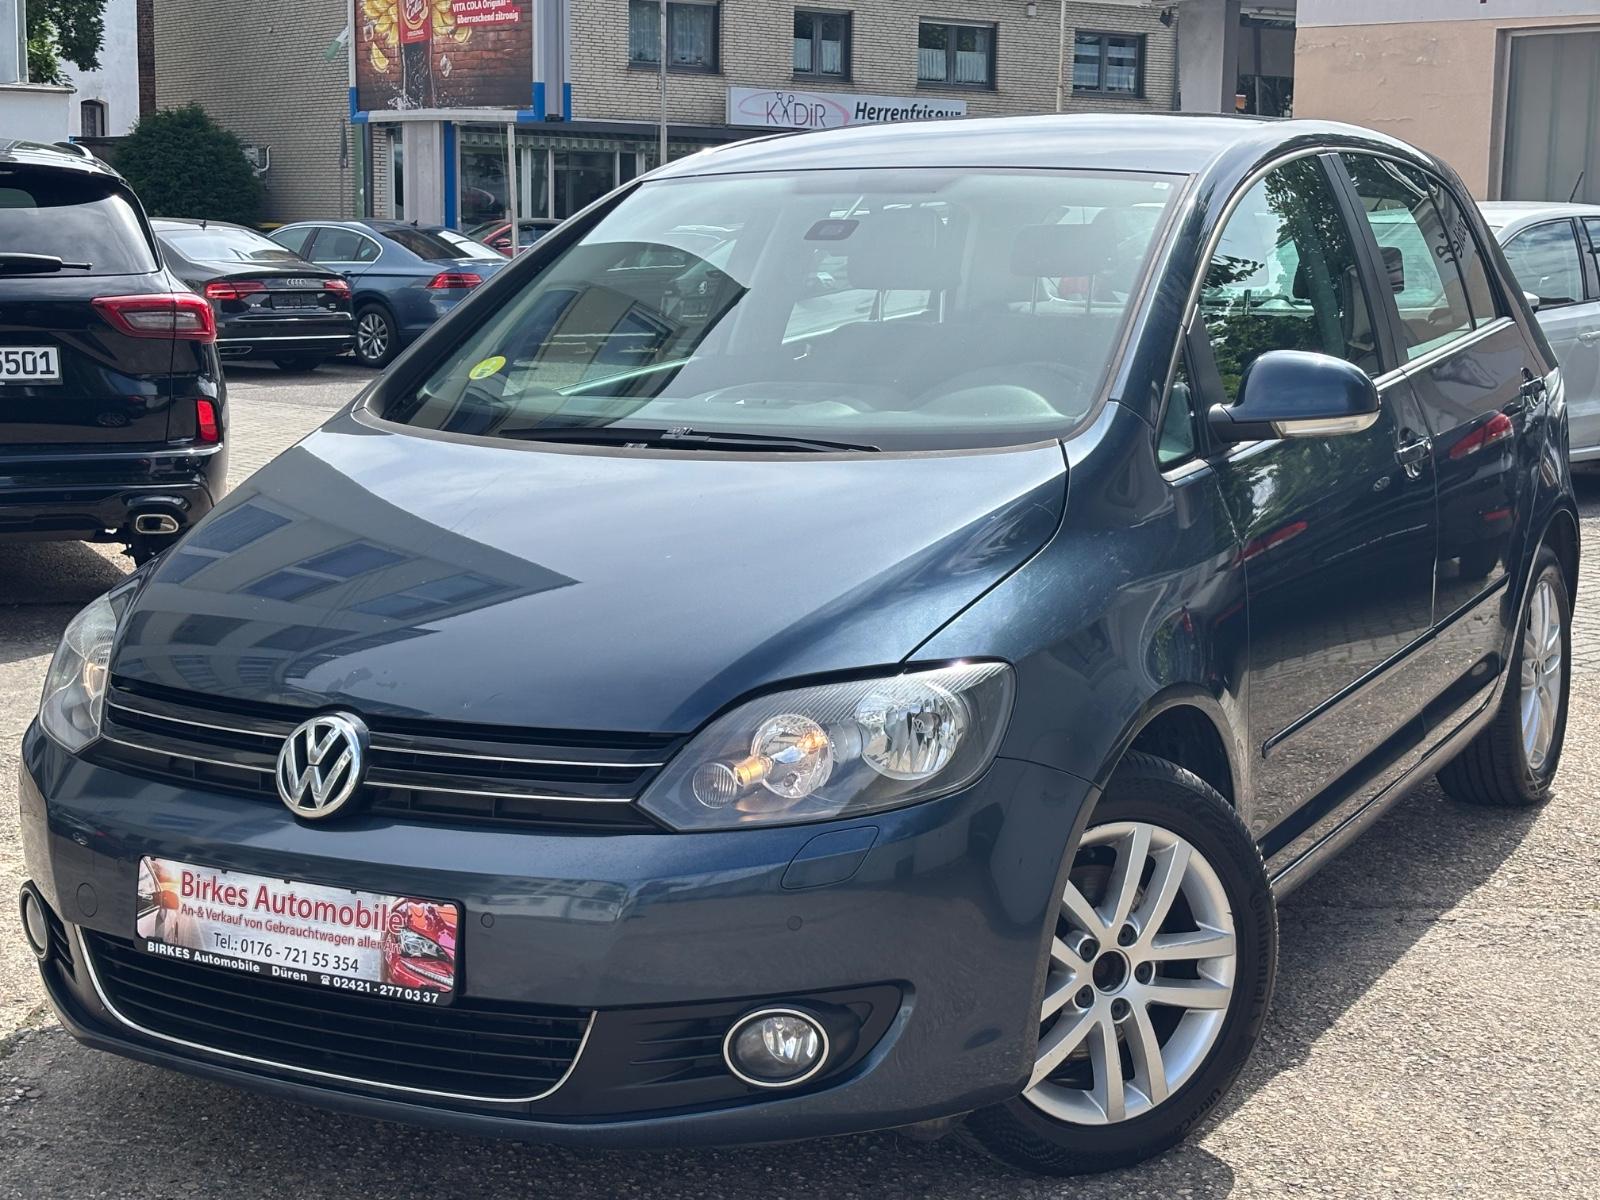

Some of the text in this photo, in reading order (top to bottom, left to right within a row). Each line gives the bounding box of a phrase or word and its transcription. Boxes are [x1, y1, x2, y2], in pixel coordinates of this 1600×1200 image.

[453, 2, 466, 12] VITA
[466, 0, 482, 11] COLA
[0, 350, 55, 375] 501
[181, 871, 403, 934] Birkes Automobile
[206, 908, 243, 925] Verkauf
[245, 917, 262, 929] von
[265, 920, 354, 946] Gebrauchtwagen
[147, 941, 190, 959] BIRKES
[194, 951, 260, 972] Automobile
[271, 965, 308, 982] Düren
[333, 977, 371, 993] 02421
[213, 932, 238, 951] Tel.:
[240, 938, 272, 957] 0176
[284, 946, 307, 964] 721
[312, 951, 329, 968] 55
[333, 956, 359, 973] 354
